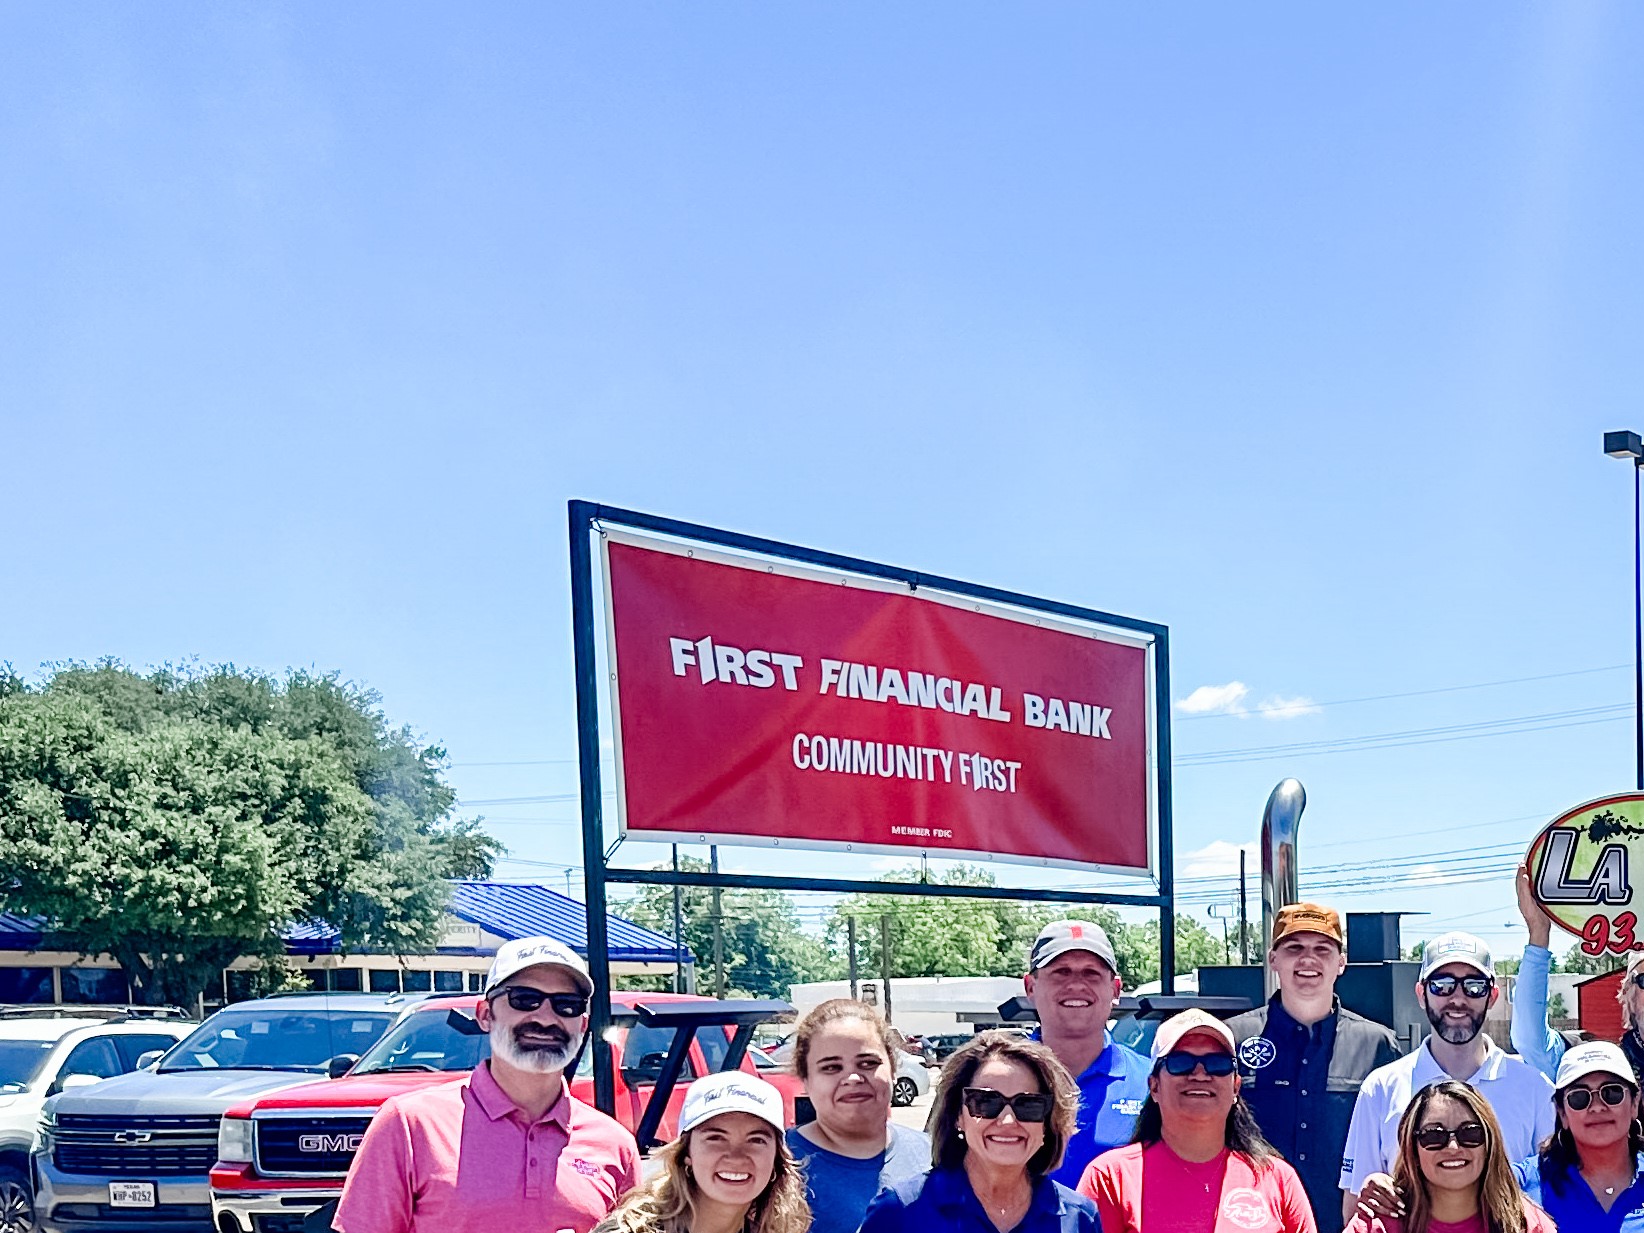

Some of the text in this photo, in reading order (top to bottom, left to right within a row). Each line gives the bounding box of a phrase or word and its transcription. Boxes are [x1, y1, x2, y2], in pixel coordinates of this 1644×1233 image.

[669, 635, 1113, 740] FIRST FINANCIAL BANK
[793, 732, 1022, 793] COMMUNITY FIRST
[891, 826, 953, 838] MEMBER FDIC
[1537, 828, 1632, 905] LA
[298, 1133, 364, 1153] GMC
